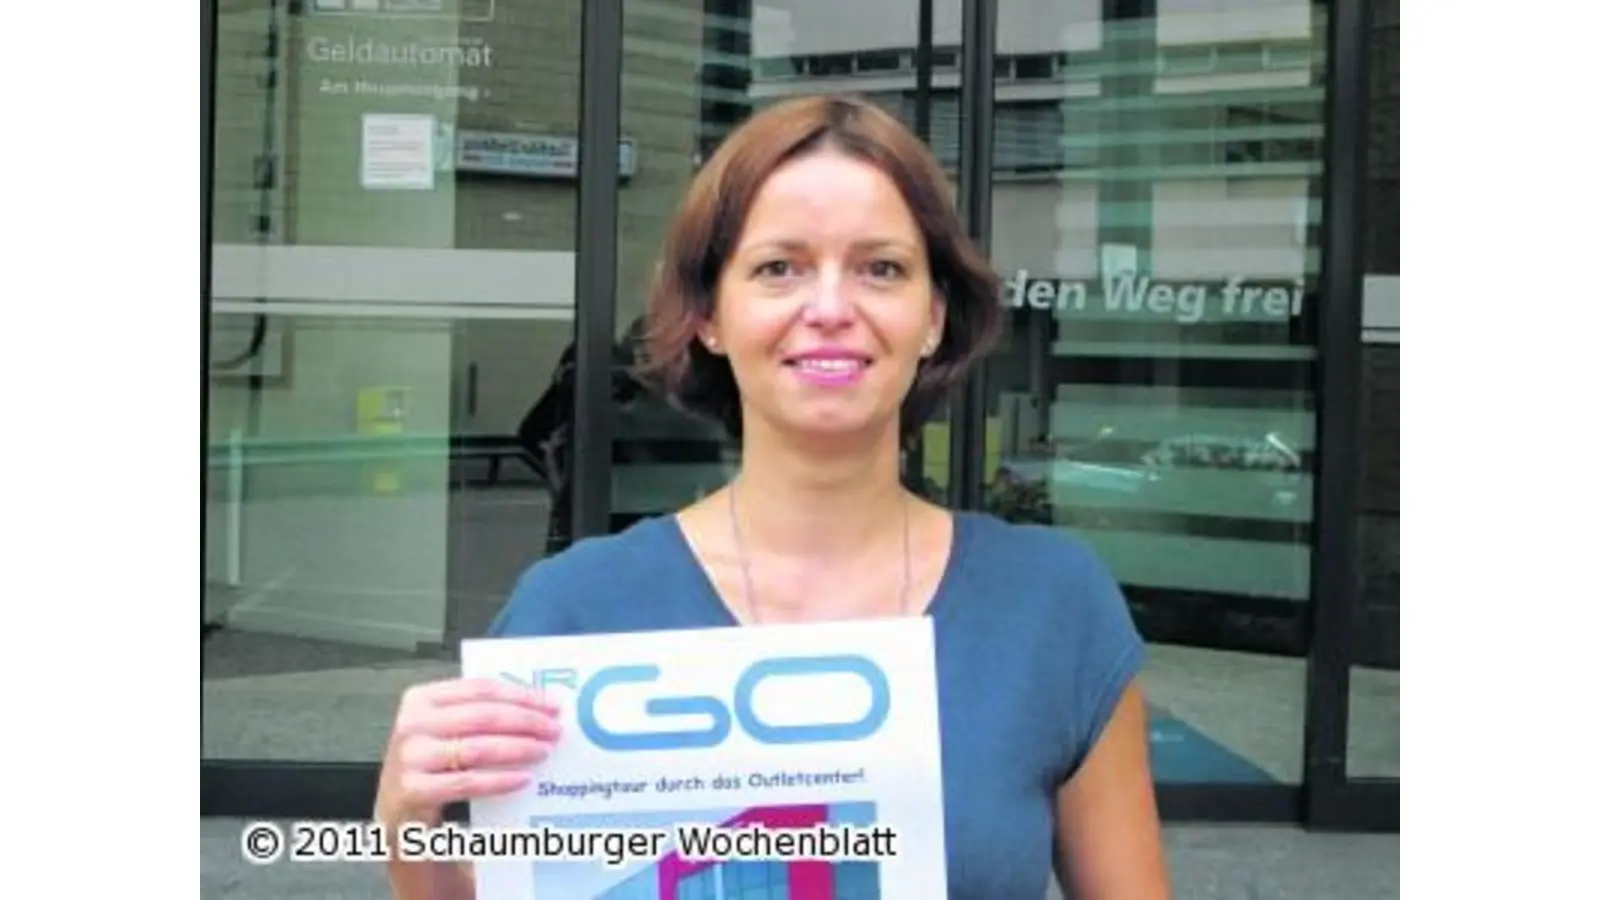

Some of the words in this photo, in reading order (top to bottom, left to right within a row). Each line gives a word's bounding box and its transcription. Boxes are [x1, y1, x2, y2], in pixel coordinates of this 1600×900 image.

[307, 36, 492, 66] Geldautomat
[1003, 269, 1087, 310] den
[1101, 275, 1206, 322] Weg
[1221, 275, 1305, 316] frei
[577, 654, 891, 751] GO
[537, 779, 647, 800] Shoppingtour
[655, 777, 705, 793] durch
[712, 774, 741, 791] das
